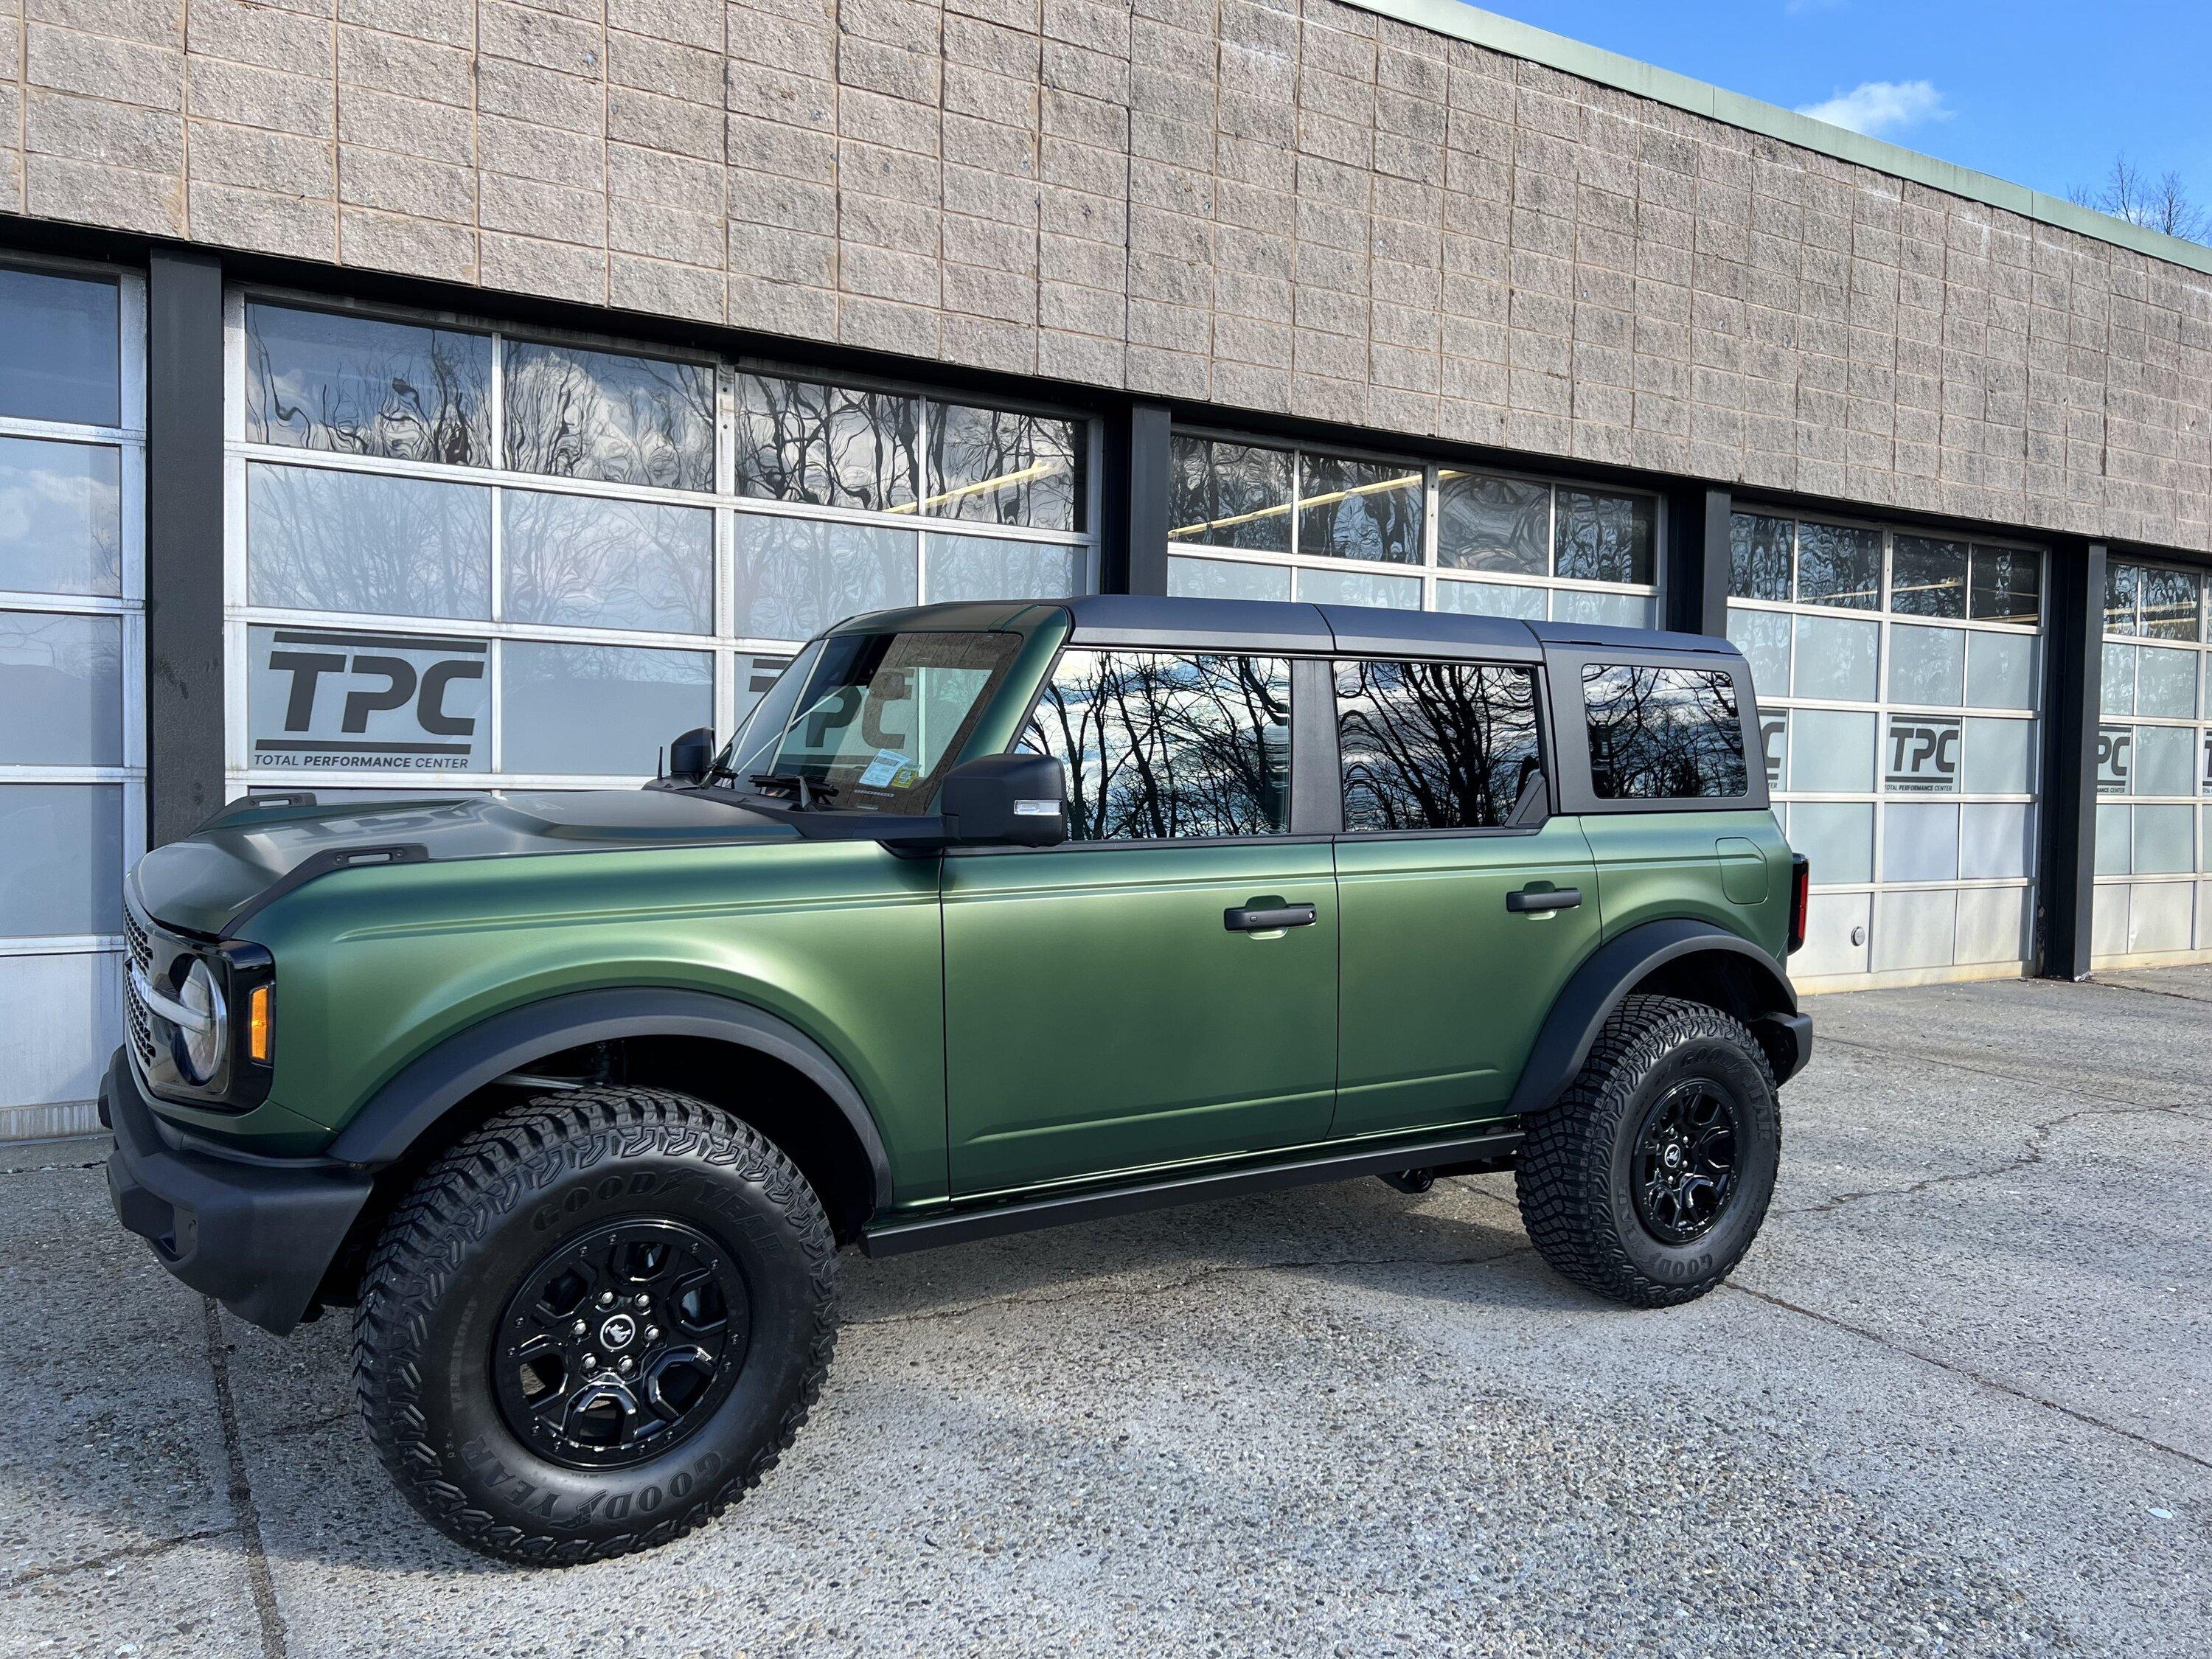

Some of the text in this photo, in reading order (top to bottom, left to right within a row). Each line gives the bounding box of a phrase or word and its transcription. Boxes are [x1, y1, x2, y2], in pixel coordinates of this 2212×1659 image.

[269, 650, 484, 736] TPC
[254, 754, 469, 769] TOTAL PERFORMANCE CENTER
[1890, 727, 1959, 773] TPC
[2098, 735, 2131, 776] PC
